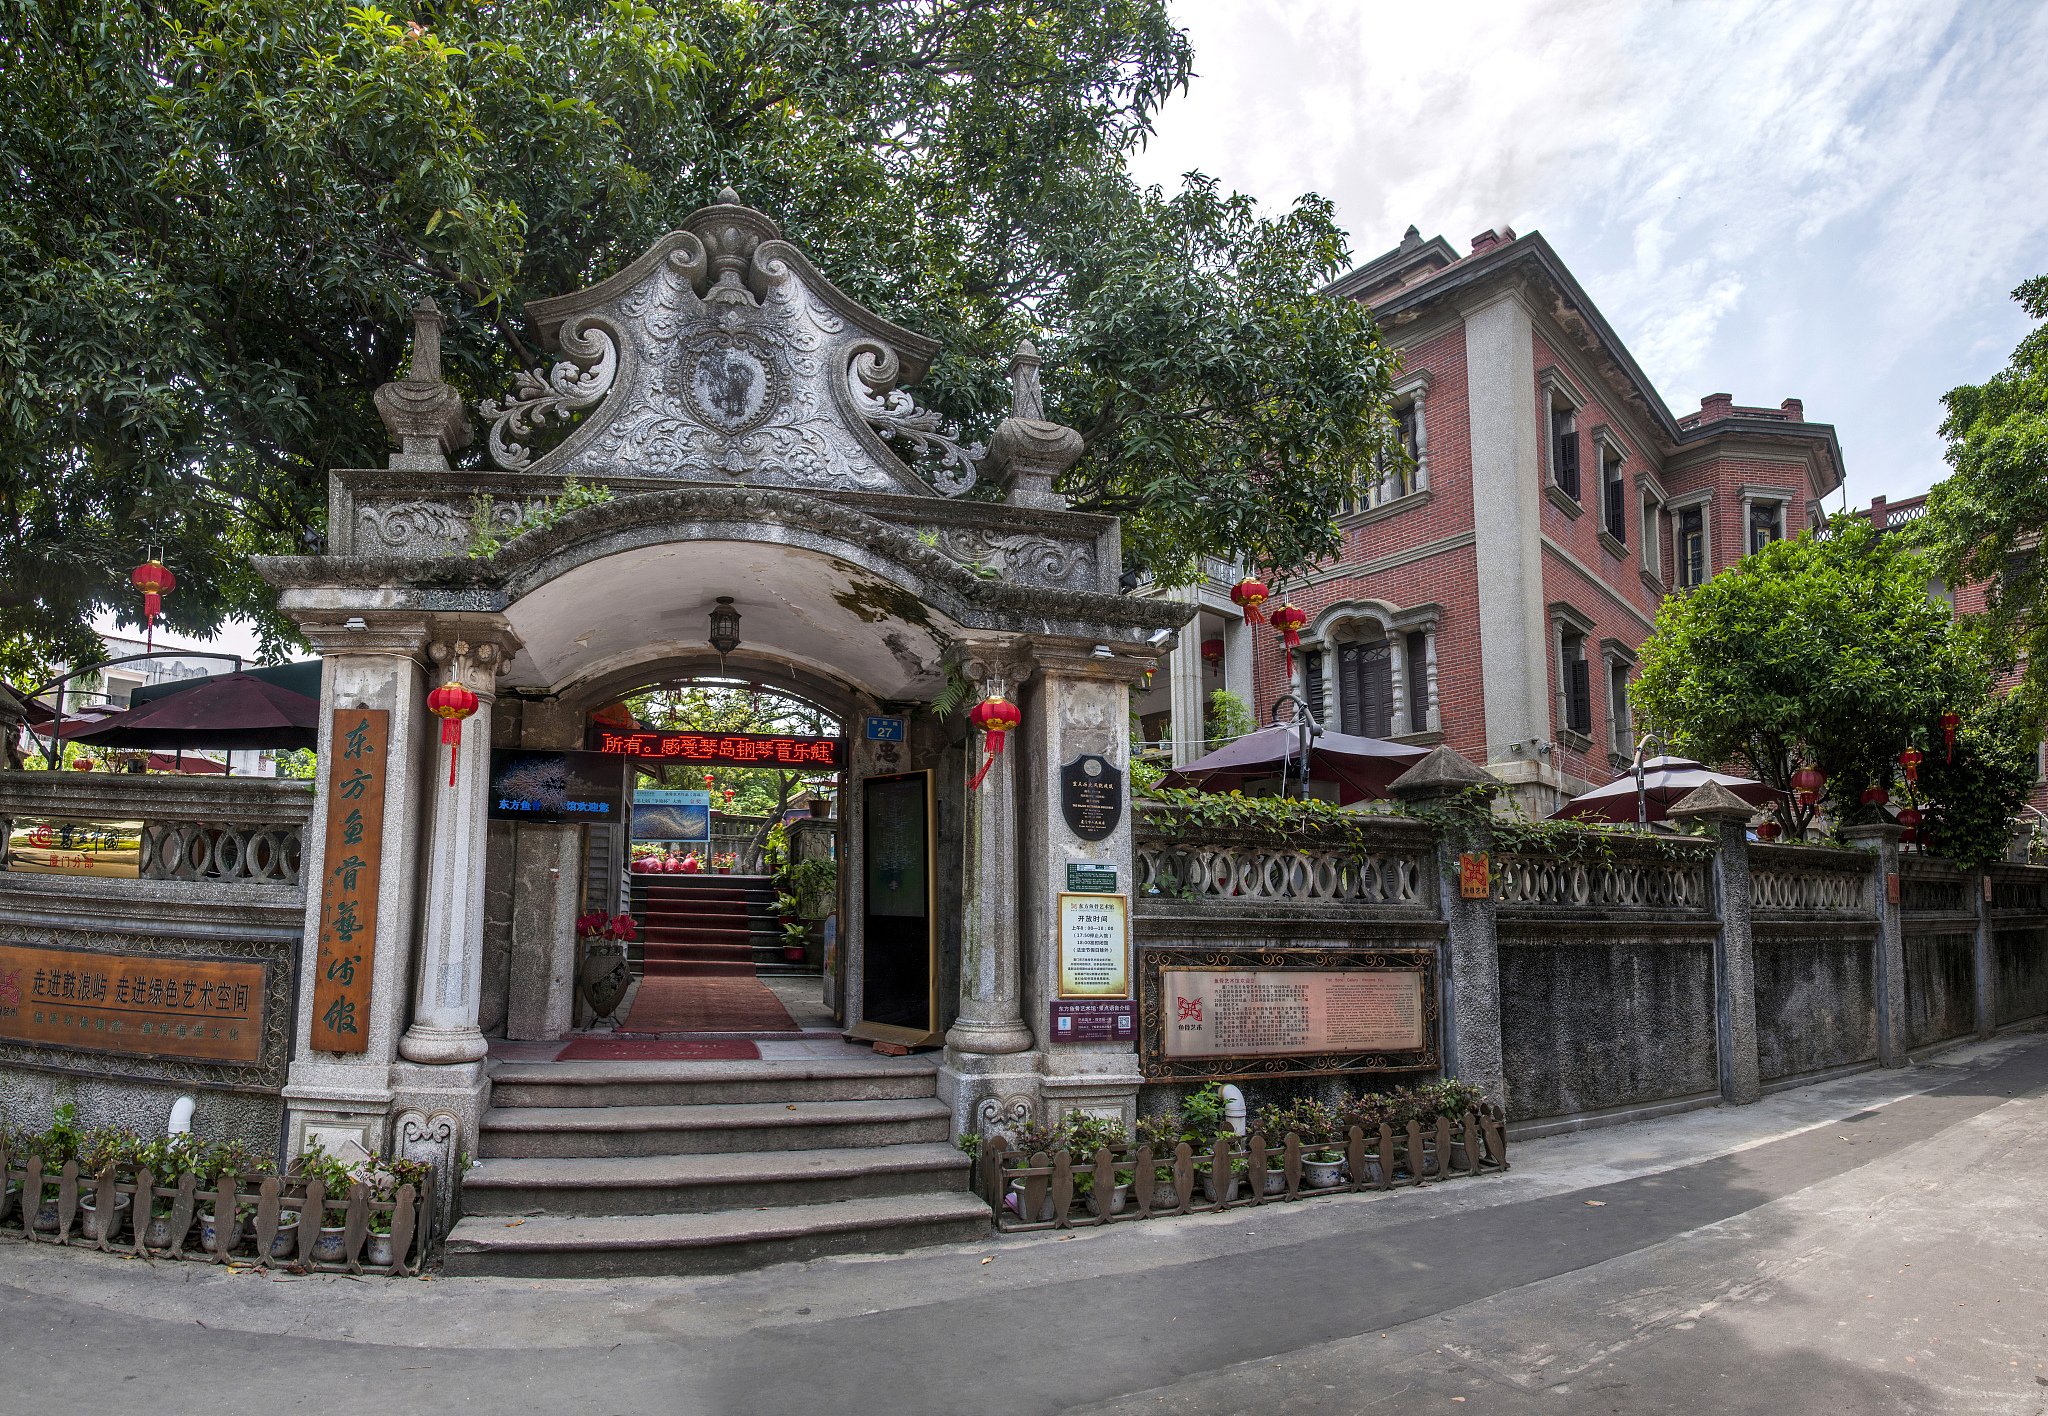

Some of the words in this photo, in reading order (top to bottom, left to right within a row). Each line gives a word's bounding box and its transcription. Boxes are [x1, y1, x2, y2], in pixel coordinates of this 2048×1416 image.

[878, 727, 893, 738] 27
[49, 854, 94, 870] 厦门分部
[1077, 915, 1108, 923] 开放时间
[31, 968, 108, 1003] 走进鼓浪屿
[114, 975, 251, 1014] 走进绿色艺术空间
[34, 1011, 122, 1033] 倡导环保理念
[141, 1021, 240, 1041] 宣传海洋文化
